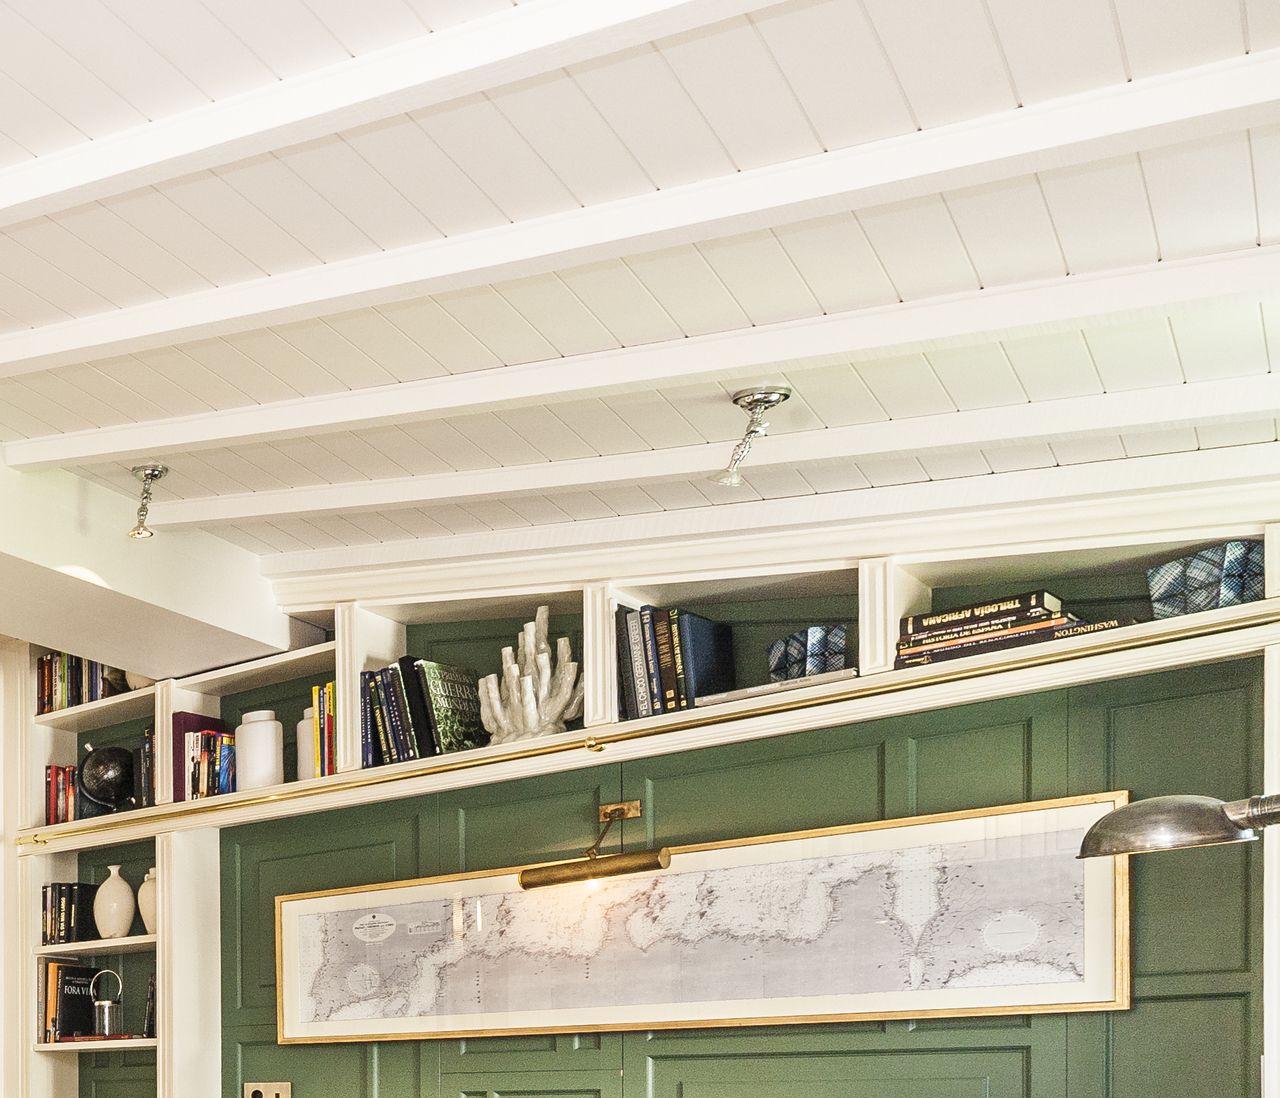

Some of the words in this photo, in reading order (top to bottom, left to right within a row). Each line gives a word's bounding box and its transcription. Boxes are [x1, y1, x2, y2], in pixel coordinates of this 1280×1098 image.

[922, 608, 972, 626] AFRICANA
[1053, 619, 1119, 638] WASHINGTON
[430, 679, 478, 700] GUERRA
[64, 985, 81, 995] FORA
